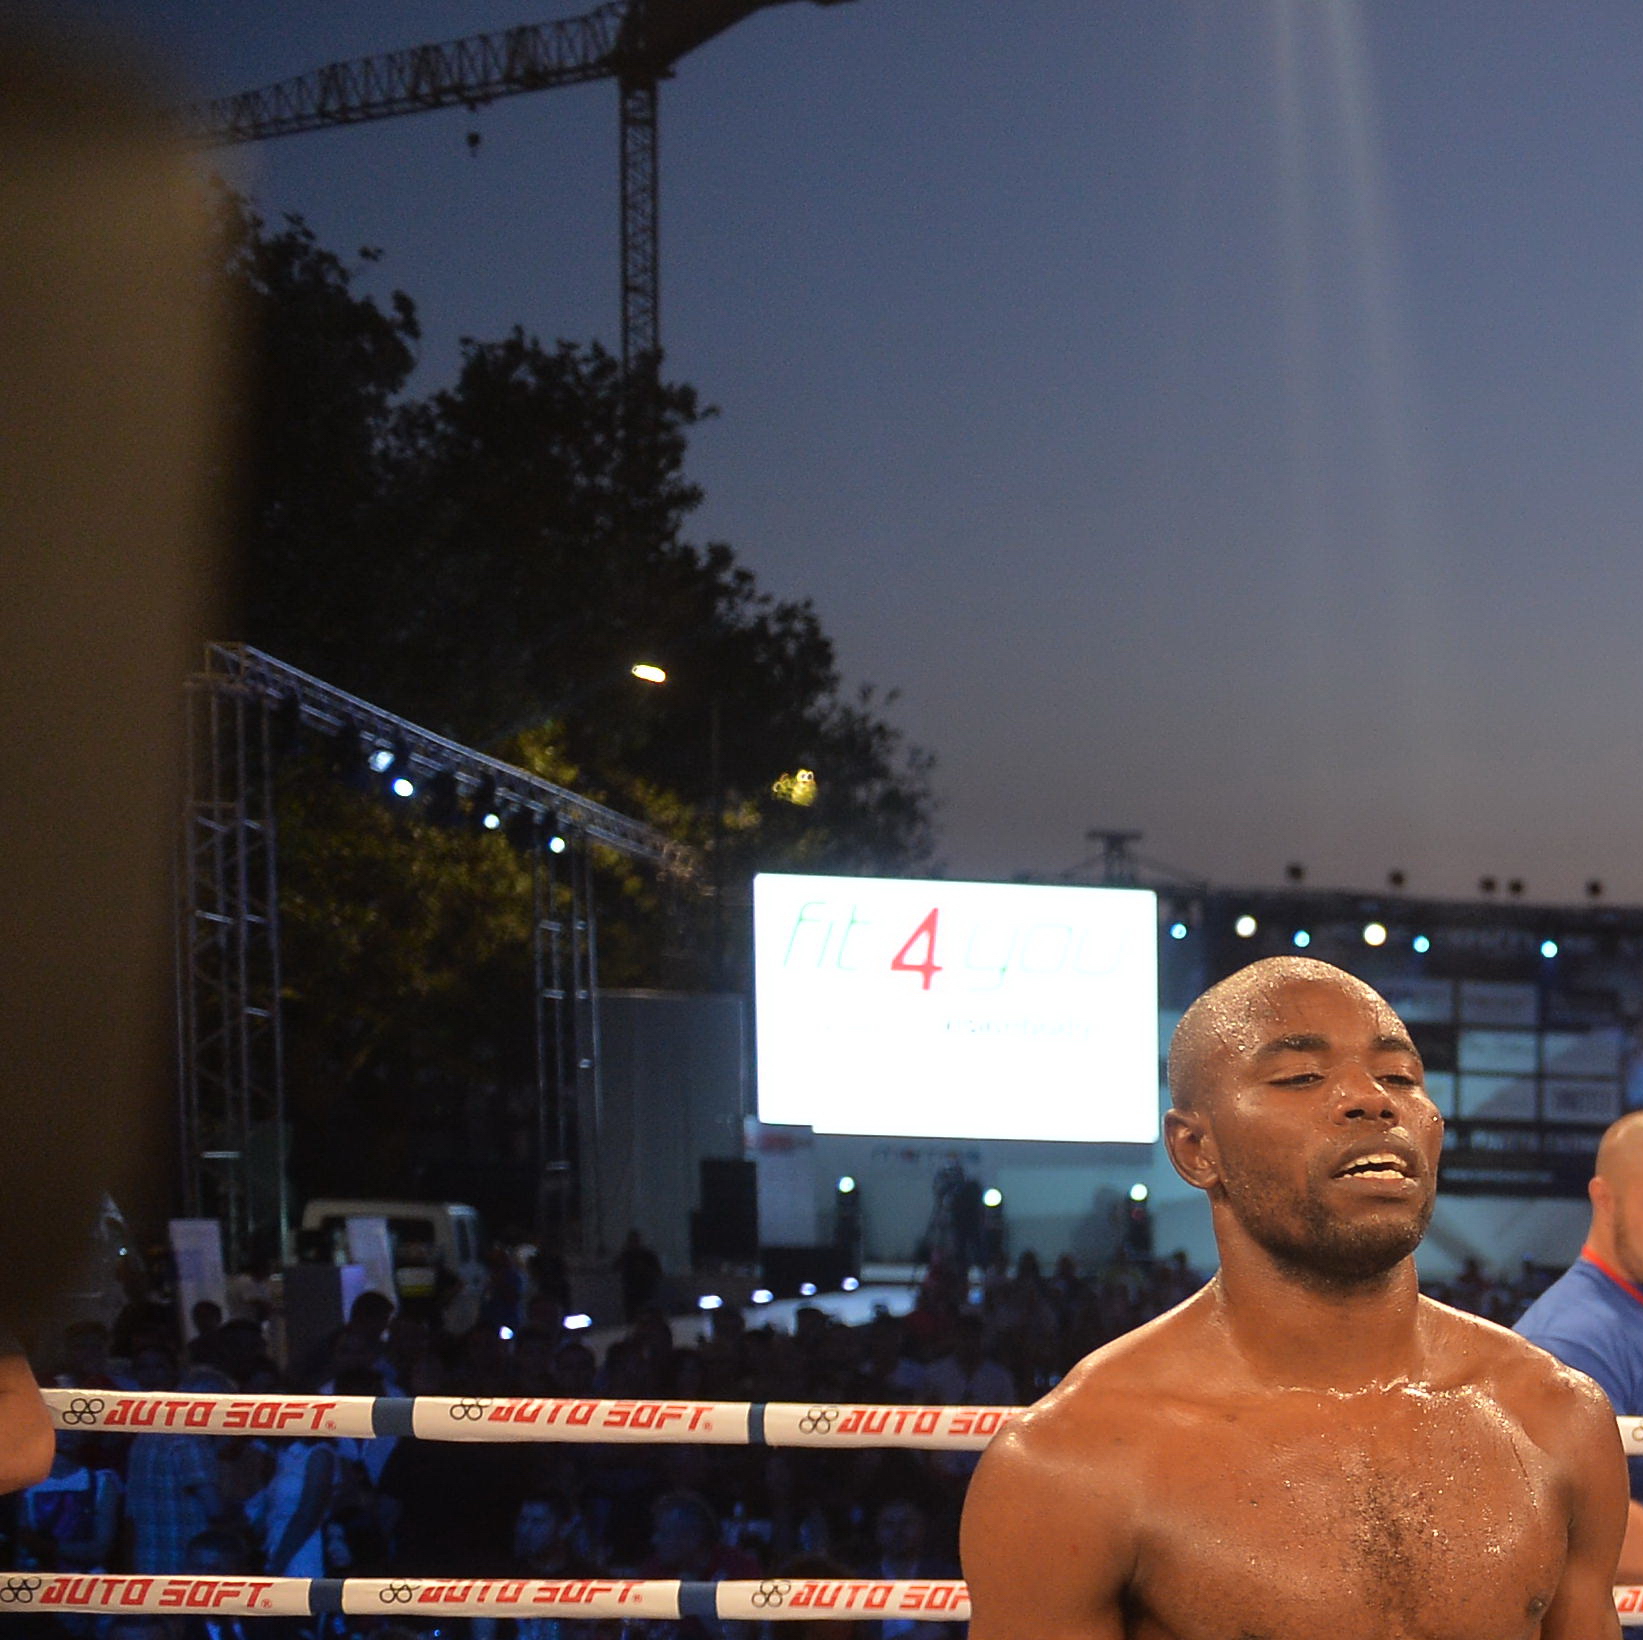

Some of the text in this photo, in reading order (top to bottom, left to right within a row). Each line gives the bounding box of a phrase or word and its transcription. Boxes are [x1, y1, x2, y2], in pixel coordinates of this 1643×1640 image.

[890, 906, 943, 991] 4
[104, 1400, 336, 1430] AUTO SOFT
[488, 1399, 713, 1430] AUTO SOFT
[836, 1408, 942, 1435] AUTO
[40, 1578, 272, 1608] AUTO SOFT
[418, 1580, 521, 1604] AUTO
[789, 1583, 970, 1609] AUTO SOF
